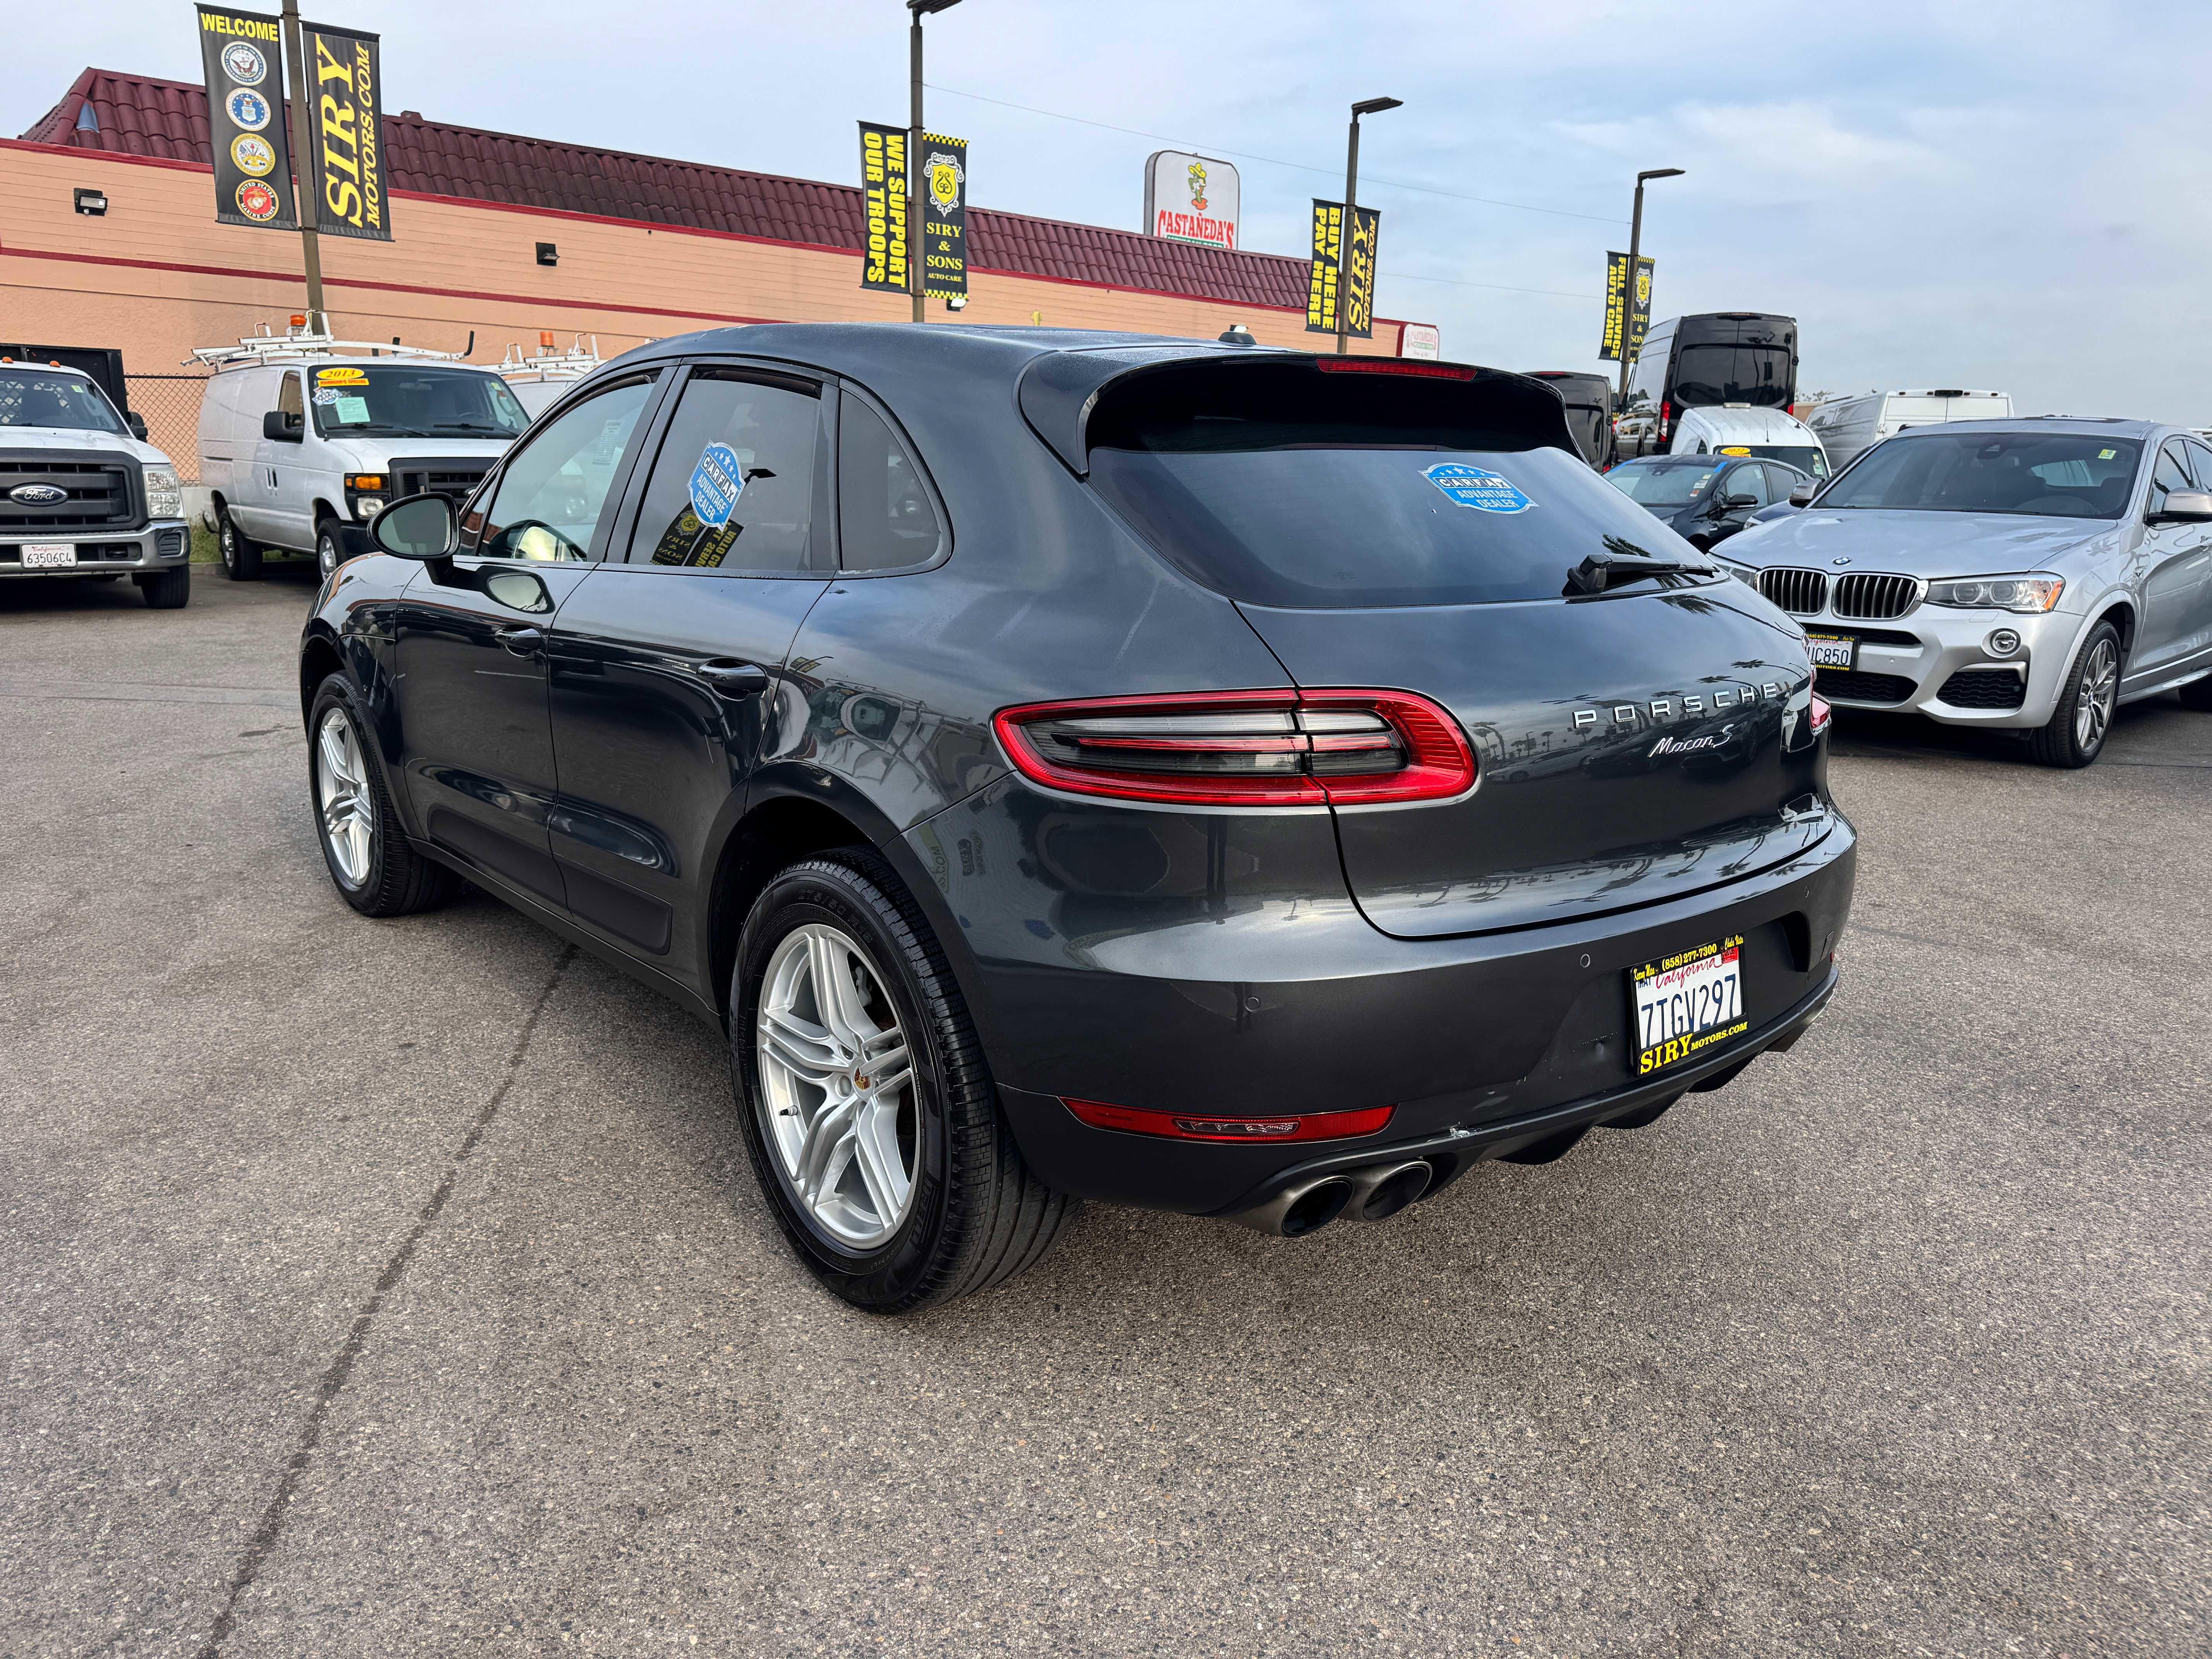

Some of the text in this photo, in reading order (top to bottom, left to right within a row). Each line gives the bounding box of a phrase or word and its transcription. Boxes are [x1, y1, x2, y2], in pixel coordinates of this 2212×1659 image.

[201, 13, 278, 42] WELCOME
[315, 33, 362, 228] SIRY
[356, 41, 380, 229] MOTORS.COM
[864, 132, 886, 283] OUR TROOPS
[886, 135, 906, 288] WE SUPPORT
[926, 222, 962, 238] SIRY
[938, 241, 951, 252] &
[926, 255, 963, 270] SONS
[1309, 207, 1327, 325] PAY HERE
[1322, 207, 1341, 329] BUY HERE
[1348, 212, 1368, 331] SIRY
[1363, 216, 1376, 331] MOTORS.COM
[1604, 264, 1617, 347] AUTO CARE
[1610, 256, 1626, 358] FULL SERVICE
[1632, 313, 1649, 323] SIRY
[1631, 335, 1644, 343] SON
[24, 488, 55, 500] Ford
[697, 474, 726, 514] ADVANTAGE
[702, 456, 734, 501] CARFAX
[1439, 477, 1510, 488] CARFAX
[1456, 490, 1518, 498] ADVANTAGE
[695, 491, 716, 521] DEALER
[1475, 500, 1520, 508] DEALER
[27, 552, 72, 564] 63506C4
[1807, 646, 1849, 665] UC850
[1572, 682, 1777, 729] PORSCHE
[1647, 723, 1735, 758] Macan S
[1656, 957, 1723, 989] California
[1662, 953, 1683, 971] (858)
[1683, 943, 1717, 963] 277-7300
[1641, 973, 1736, 1048] 7TGV297
[1640, 1032, 1693, 1074] SIRY
[1690, 1022, 1748, 1051] MOTORS.COM
